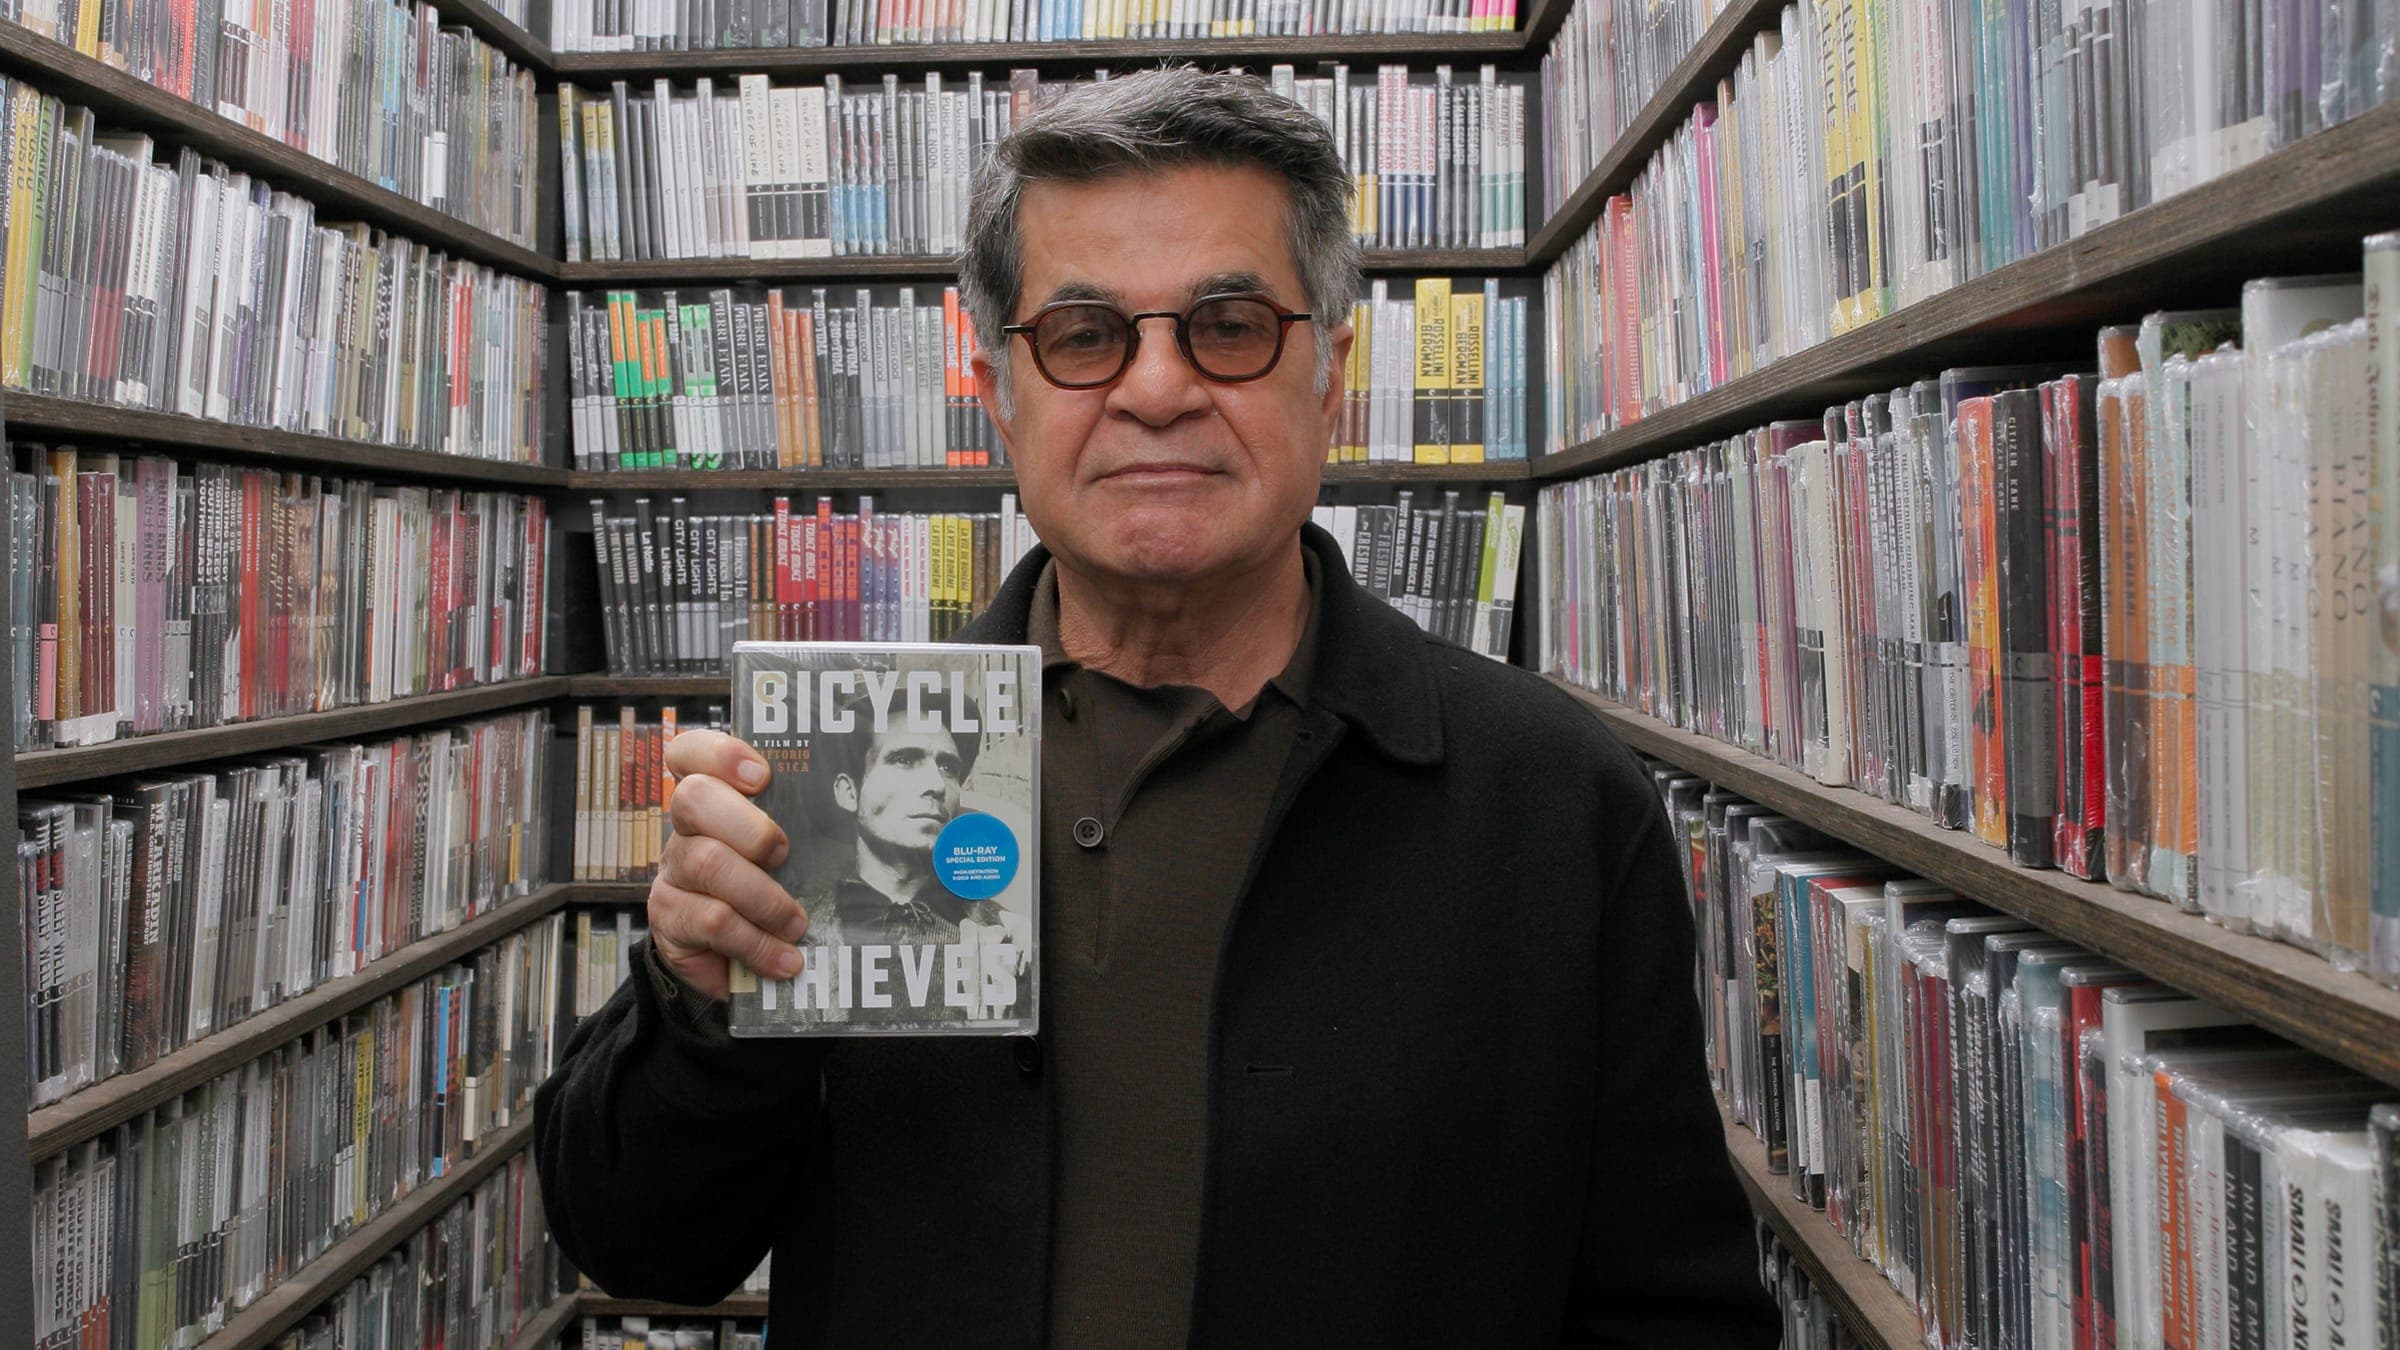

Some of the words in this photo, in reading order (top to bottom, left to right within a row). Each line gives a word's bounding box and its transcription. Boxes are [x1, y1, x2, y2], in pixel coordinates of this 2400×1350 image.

[927, 92, 937, 134] PURPLE
[943, 98, 953, 143] PURPLE
[956, 100, 966, 144] PURPLE
[16, 123, 27, 189] POSTO
[34, 119, 51, 220] FIDANZATI
[928, 141, 938, 169] NOON
[944, 144, 954, 174] NOON
[956, 148, 967, 178] NOON
[713, 301, 728, 346] PIERRE
[815, 302, 826, 320] 310
[857, 300, 867, 341] medium
[901, 297, 911, 317] LIFE
[902, 320, 911, 331] IS
[734, 307, 748, 350] PIERRE
[752, 307, 767, 350] PIERRE
[816, 327, 827, 356] YUMA
[875, 318, 883, 359] medium
[886, 315, 898, 357] medium
[930, 319, 941, 338] LIFE
[1432, 318, 1445, 377] ROSSELLINI
[718, 349, 731, 386] ETAIX
[832, 345, 843, 375] YUMA
[847, 346, 858, 376] YUMA
[860, 341, 870, 363] cool
[876, 360, 886, 382] cool
[891, 358, 901, 379] cool
[931, 354, 943, 387] SWEET
[1420, 325, 1432, 377] BERGMAN
[1455, 332, 1467, 385] BERGMAN
[1467, 325, 1480, 385] ROSSELLINI
[737, 354, 750, 391] ETAIX
[756, 354, 769, 391] ETAIX
[1995, 421, 2004, 470] CITIZEN
[2008, 416, 2018, 467] CITIZEN
[198, 478, 206, 524] YOUTH
[206, 479, 214, 525] YOUTH
[214, 478, 222, 532] FIGHTING
[223, 478, 231, 533] FIGHTING
[271, 485, 280, 529] NIGHT
[1399, 500, 1409, 518] RIOT
[1902, 477, 1912, 542] INCREDIBLE
[1923, 484, 1932, 523] GEMS
[2010, 479, 2019, 511] KANE
[277, 507, 286, 551] NIGHT
[286, 508, 296, 552] NIGHT
[642, 531, 653, 545] La
[675, 519, 685, 546] CITY
[690, 529, 700, 556] CITY
[706, 529, 716, 556] CITY
[777, 509, 789, 537] TOUKI
[791, 524, 801, 552] TOUKI
[805, 522, 815, 550] TOUKI
[1397, 529, 1407, 545] CELL
[1399, 519, 1408, 529] IN
[1413, 517, 1423, 534] RIOT
[1429, 520, 1439, 538] RIOT
[2332, 464, 2347, 621] PIANO
[2352, 454, 2368, 616] PIANO
[197, 537, 206, 584] BEAST
[205, 538, 214, 584] BEAST
[213, 542, 221, 584] ELEGY
[222, 542, 230, 583] ELEGY
[269, 552, 279, 587] CITY
[643, 546, 654, 573] Notte
[660, 547, 670, 559] La
[677, 549, 687, 585] LIGHTS
[719, 540, 732, 582] Frances
[734, 536, 747, 578] Frances
[777, 538, 788, 566] BOUKI
[791, 553, 801, 582] BOUKI
[805, 552, 816, 580] BOUKI
[1395, 546, 1405, 566] BLOCK
[1408, 562, 1418, 582] BLOCK
[1410, 546, 1420, 562] CELL
[1425, 550, 1436, 565] CELL
[276, 575, 285, 610] CITY
[286, 575, 295, 609] CITY
[691, 559, 702, 595] LIGHTS
[707, 558, 717, 594] LIGHTS
[720, 584, 733, 601] Ha
[735, 581, 747, 597] Ha
[1424, 566, 1434, 588] BLOCK
[1905, 544, 1915, 609] SHRINKING
[753, 671, 1017, 733] BICYCLE
[762, 750, 809, 760] ITTORIO
[777, 761, 809, 772] SICA
[1951, 727, 1959, 770] COLLECTION
[37, 823, 50, 853] THE
[53, 819, 65, 849] THE
[154, 801, 167, 844] MR.
[953, 846, 997, 856] BLU-RAY
[977, 855, 1006, 863] EDITION
[145, 838, 155, 907] CONFIDENTIAL
[54, 891, 65, 936] SLEEP
[148, 845, 163, 944] ARKADIN
[38, 895, 50, 940] SLEEP
[143, 908, 151, 945] REPORT
[38, 949, 50, 990] WELL
[54, 942, 65, 985] WELL
[2158, 1100, 2170, 1223] HOLLYWOOD
[57, 1167, 67, 1240] BRUTE
[2174, 1126, 2187, 1252] HOLLYWOOD
[67, 1197, 76, 1257] BRUTE
[2226, 1171, 2237, 1272] INLAND
[2244, 1182, 2256, 1285] INLAND
[2288, 1183, 2306, 1270] SMALL
[2325, 1199, 2345, 1290] SMALL
[55, 1246, 66, 1321] FORCE
[66, 1260, 75, 1319] FORCE
[75, 1252, 83, 1311] FORCE
[2162, 1231, 2173, 1319] SHUFFLE
[2180, 1259, 2192, 1349] SHUFFLE
